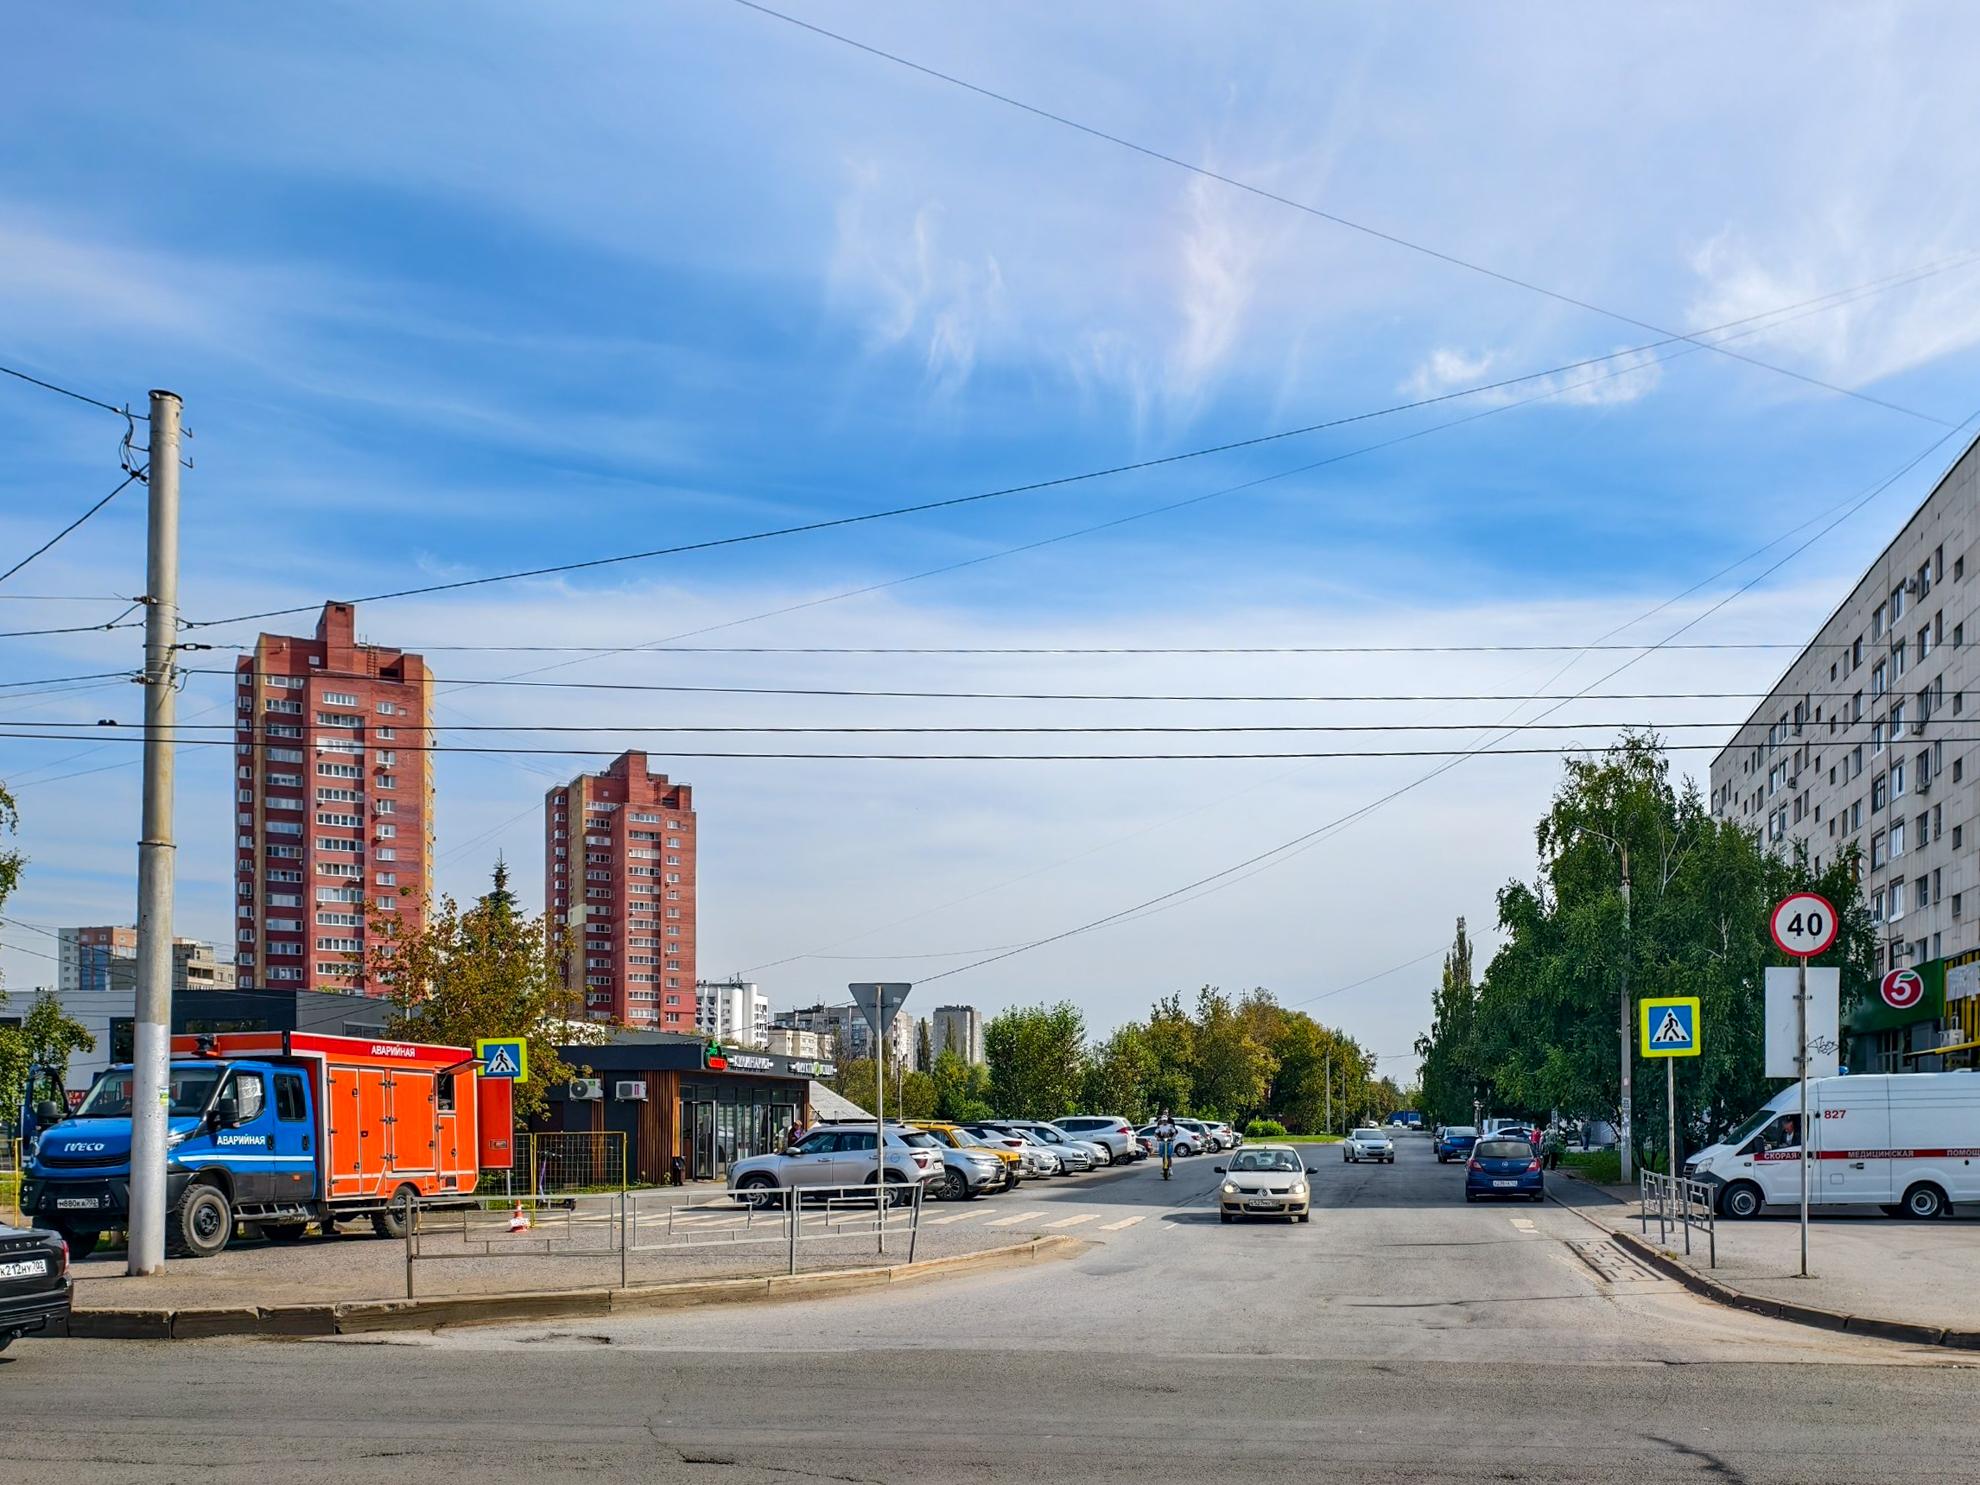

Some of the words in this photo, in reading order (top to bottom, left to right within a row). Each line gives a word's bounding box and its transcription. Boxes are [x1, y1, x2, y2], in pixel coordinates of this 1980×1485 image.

[1788, 913, 1822, 937] 40
[1891, 972, 1915, 1001] 5
[371, 1044, 416, 1057] АВАРИЙНАЯ
[1824, 1110, 1847, 1119] 827
[217, 1133, 266, 1145] АВАРИЙНАЯ
[64, 1142, 105, 1152] IVECO
[1764, 1152, 1798, 1161] СКОРАЯ
[1848, 1150, 1915, 1159] МЕДИЦИНСКАЯ
